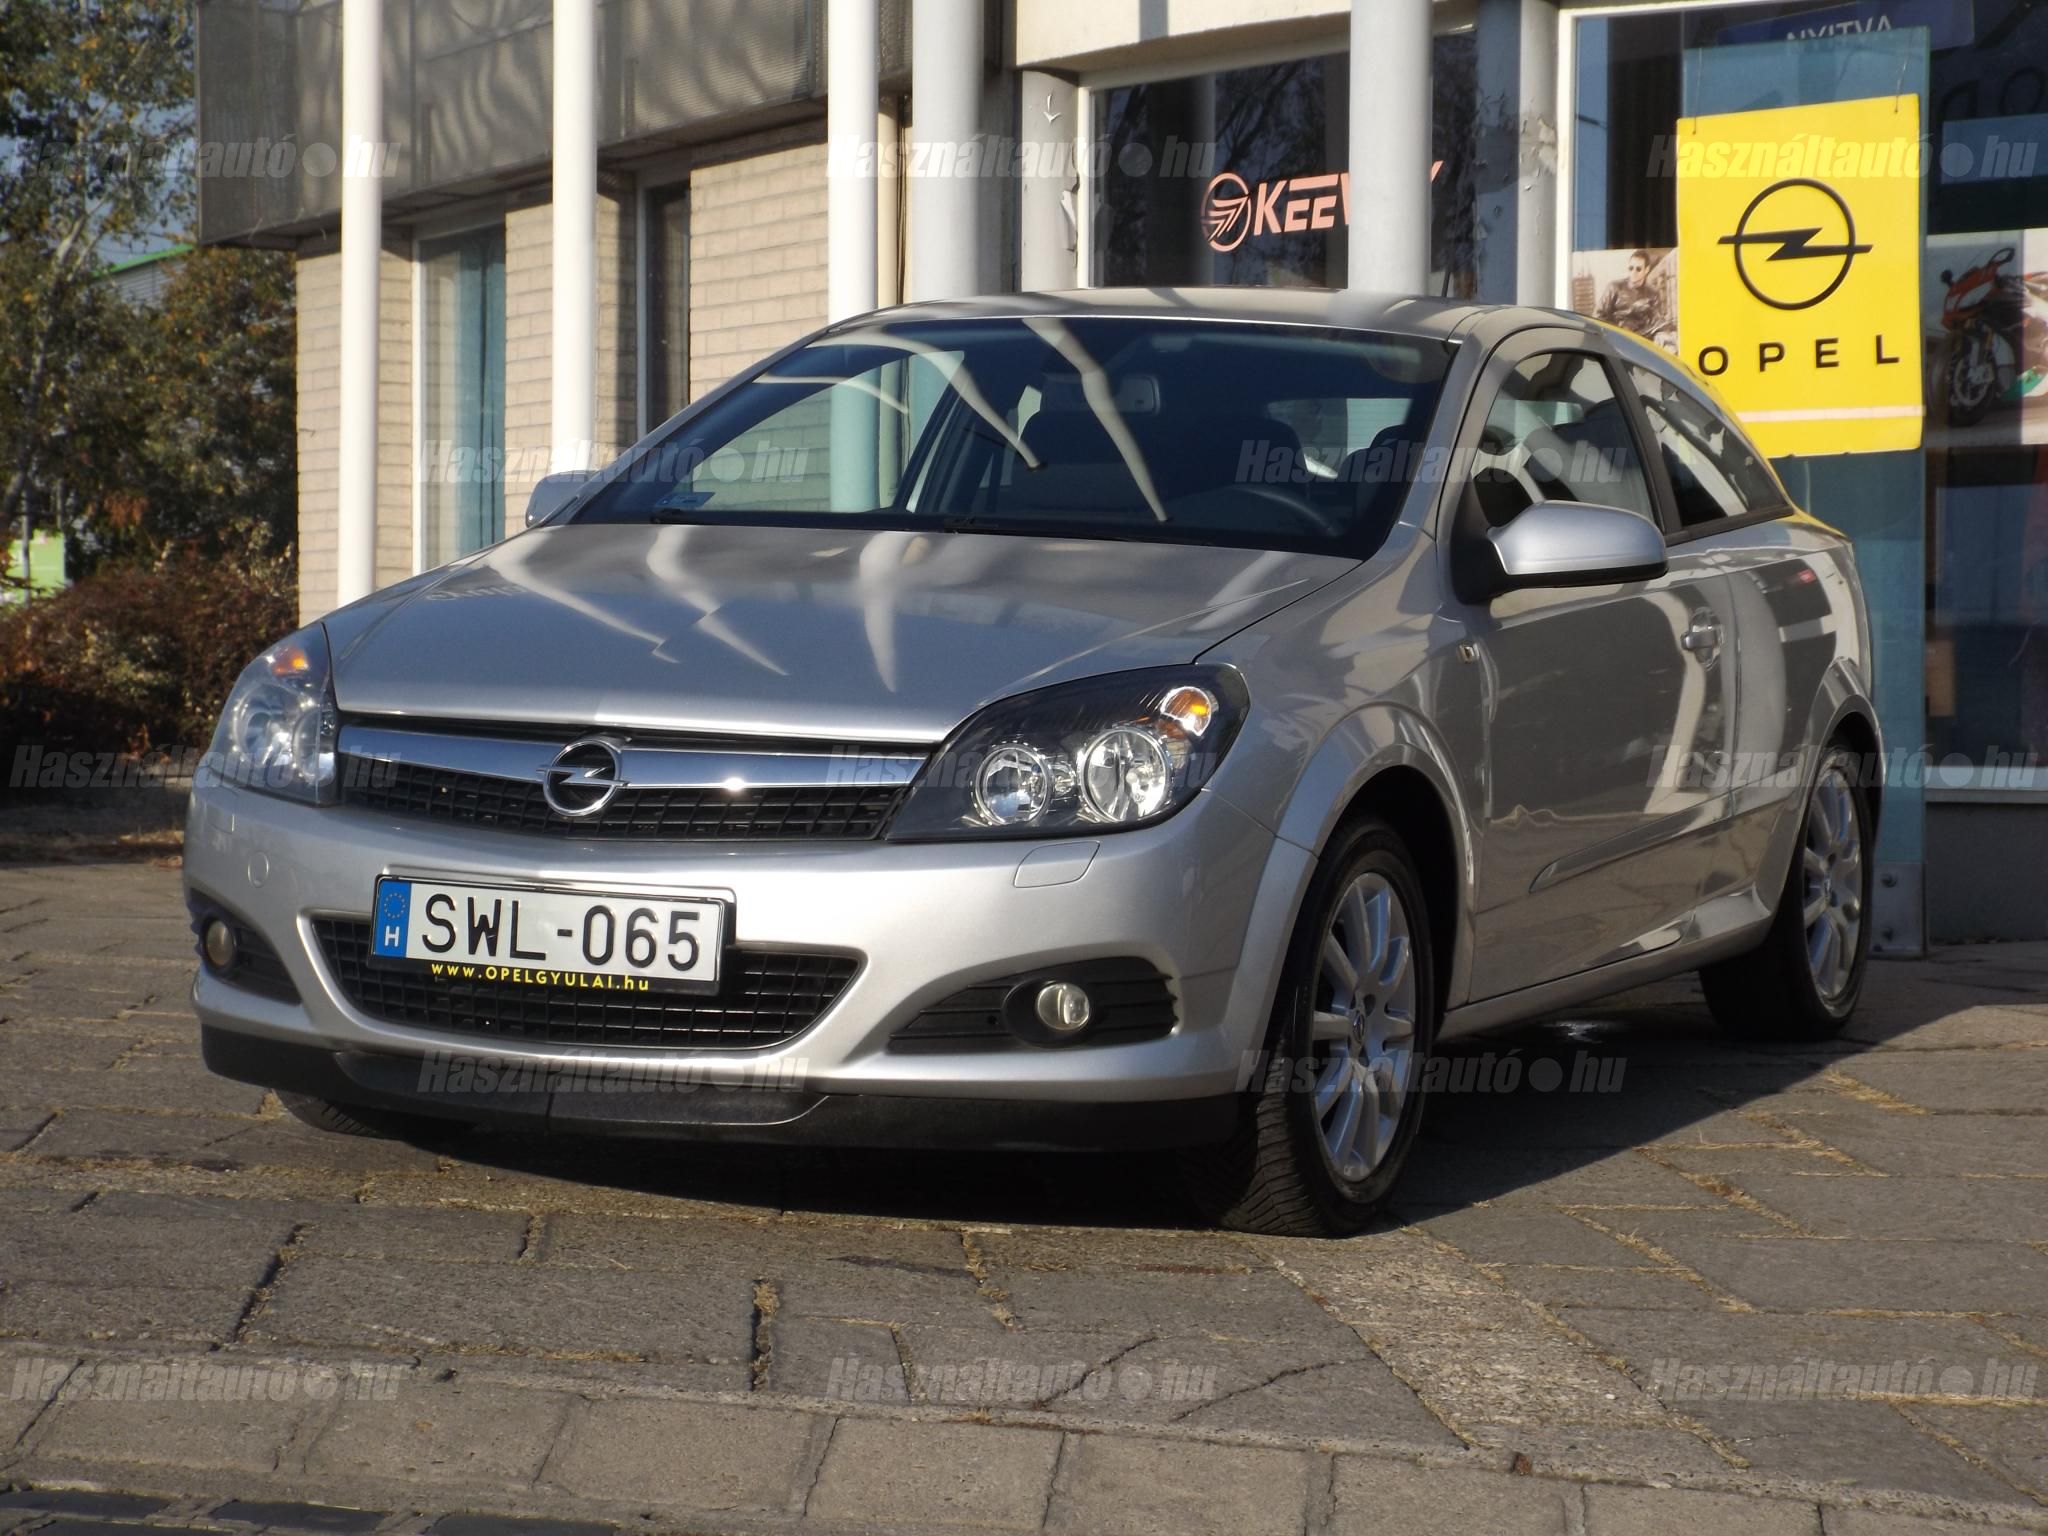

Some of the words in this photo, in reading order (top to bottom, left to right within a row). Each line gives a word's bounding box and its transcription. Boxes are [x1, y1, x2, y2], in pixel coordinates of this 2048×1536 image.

[1699, 334, 1900, 376] OPEL
[384, 926, 399, 947] H
[421, 893, 700, 972] SWL-065
